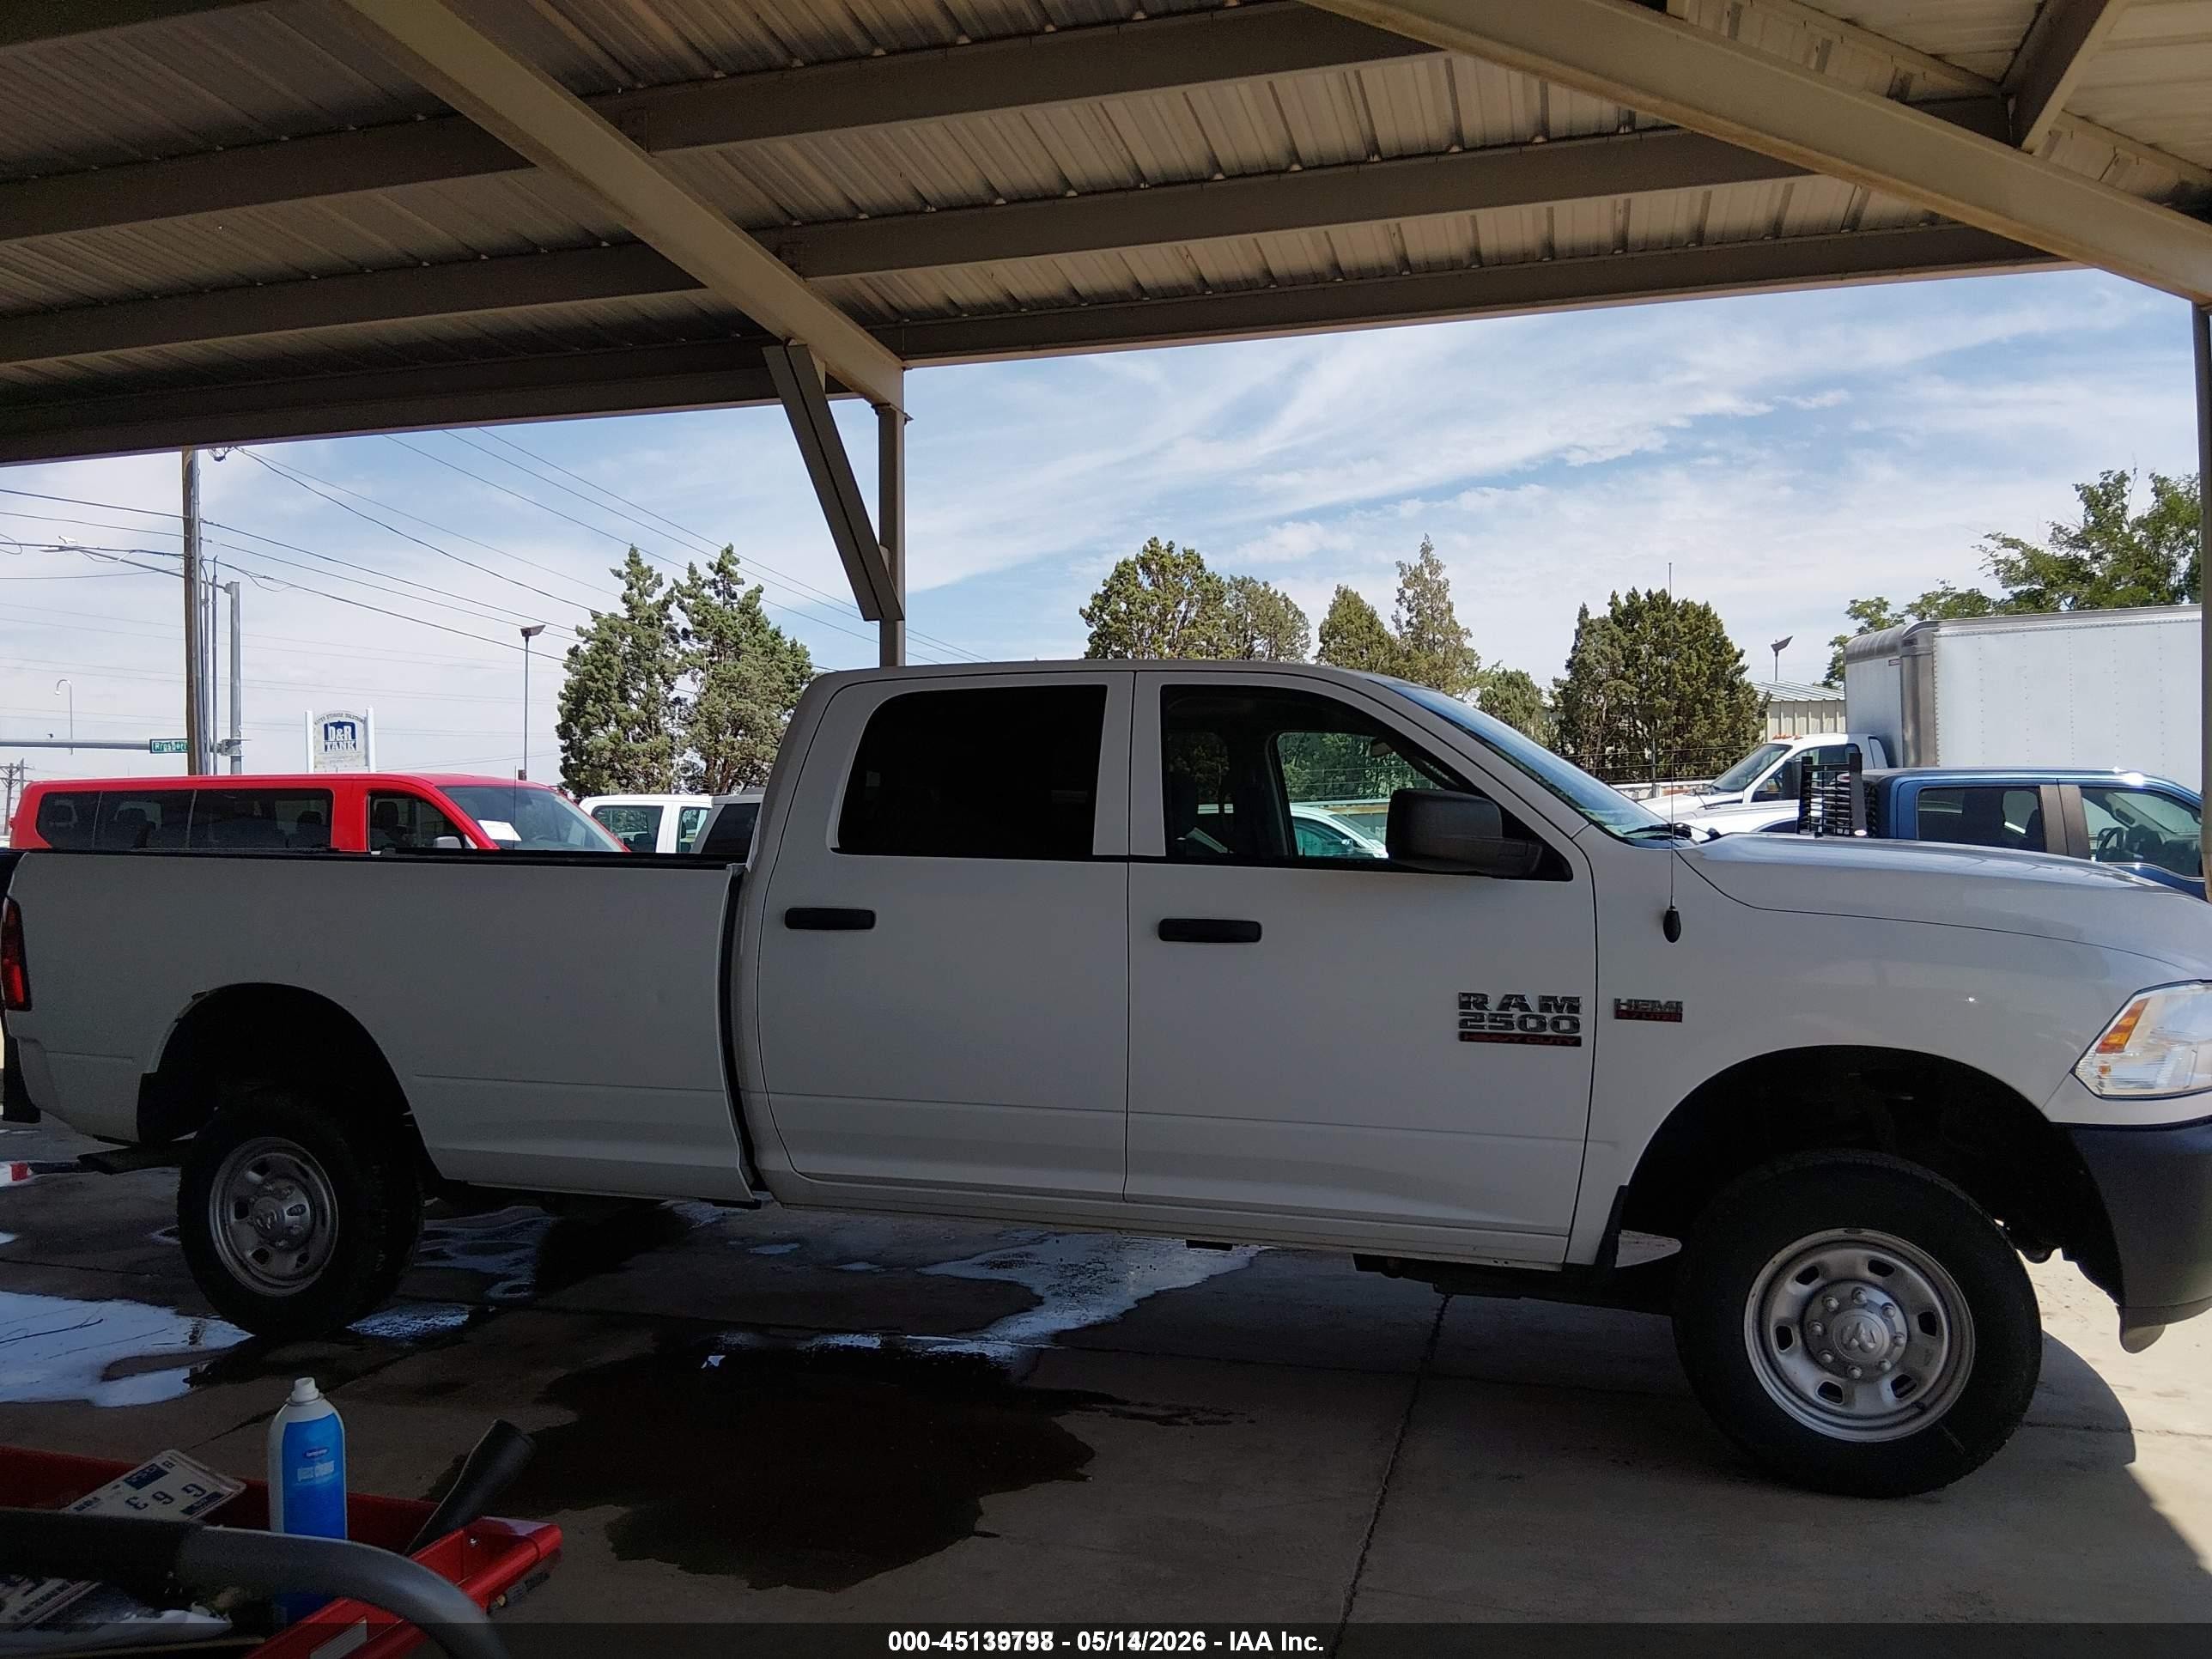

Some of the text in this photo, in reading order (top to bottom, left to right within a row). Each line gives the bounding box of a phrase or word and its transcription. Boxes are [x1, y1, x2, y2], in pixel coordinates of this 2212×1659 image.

[328, 725, 352, 741] D&R
[325, 740, 356, 752] TANK
[1458, 992, 1582, 1014] RAM
[1613, 998, 1683, 1012] HEMI
[1458, 1012, 1582, 1034] 2500
[1528, 1035, 1577, 1046] DUTY
